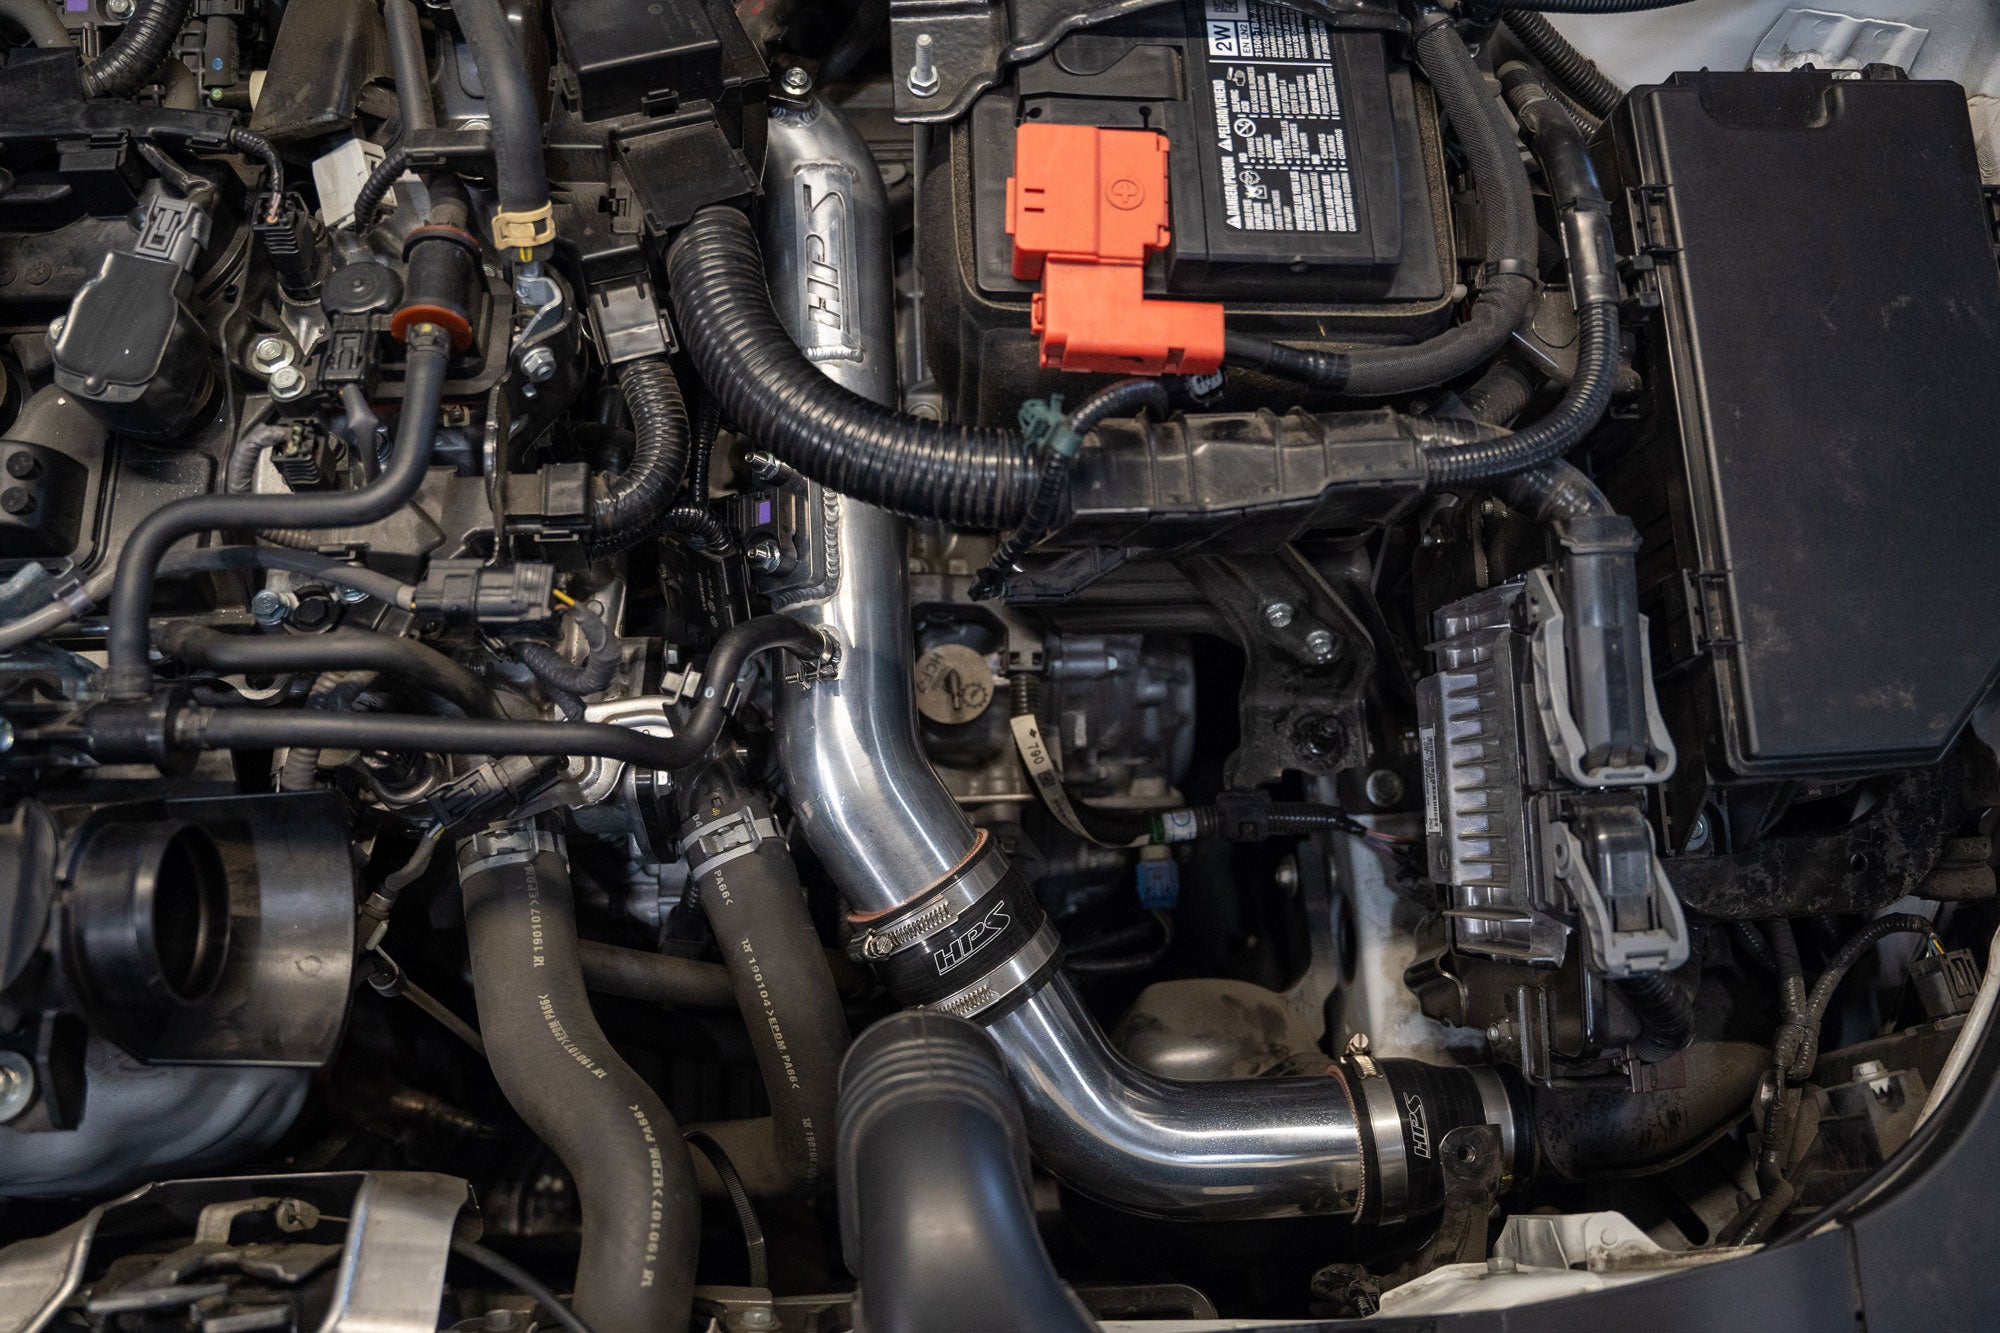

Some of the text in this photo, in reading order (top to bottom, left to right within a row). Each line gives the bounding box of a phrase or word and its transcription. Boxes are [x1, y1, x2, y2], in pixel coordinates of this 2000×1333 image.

[1214, 25, 1233, 51] 2W
[1241, 24, 1251, 53] EN LN2
[1286, 45, 1294, 58] TEST
[1212, 79, 1231, 138] PELIGRO/VENENO
[1312, 154, 1321, 165] NO
[1318, 133, 1328, 159] CHISPAS
[1327, 135, 1337, 159] FLAMAS
[1335, 129, 1347, 159] CIGARROS
[1221, 156, 1240, 215] DANGER/POISON
[803, 184, 850, 335] HPS
[916, 652, 944, 694] HCF-2
[1027, 742, 1045, 765] 790
[714, 869, 734, 906] PA66<
[531, 908, 544, 952] 190107
[933, 900, 1011, 976] HPS
[1403, 1092, 1431, 1159] HPS
